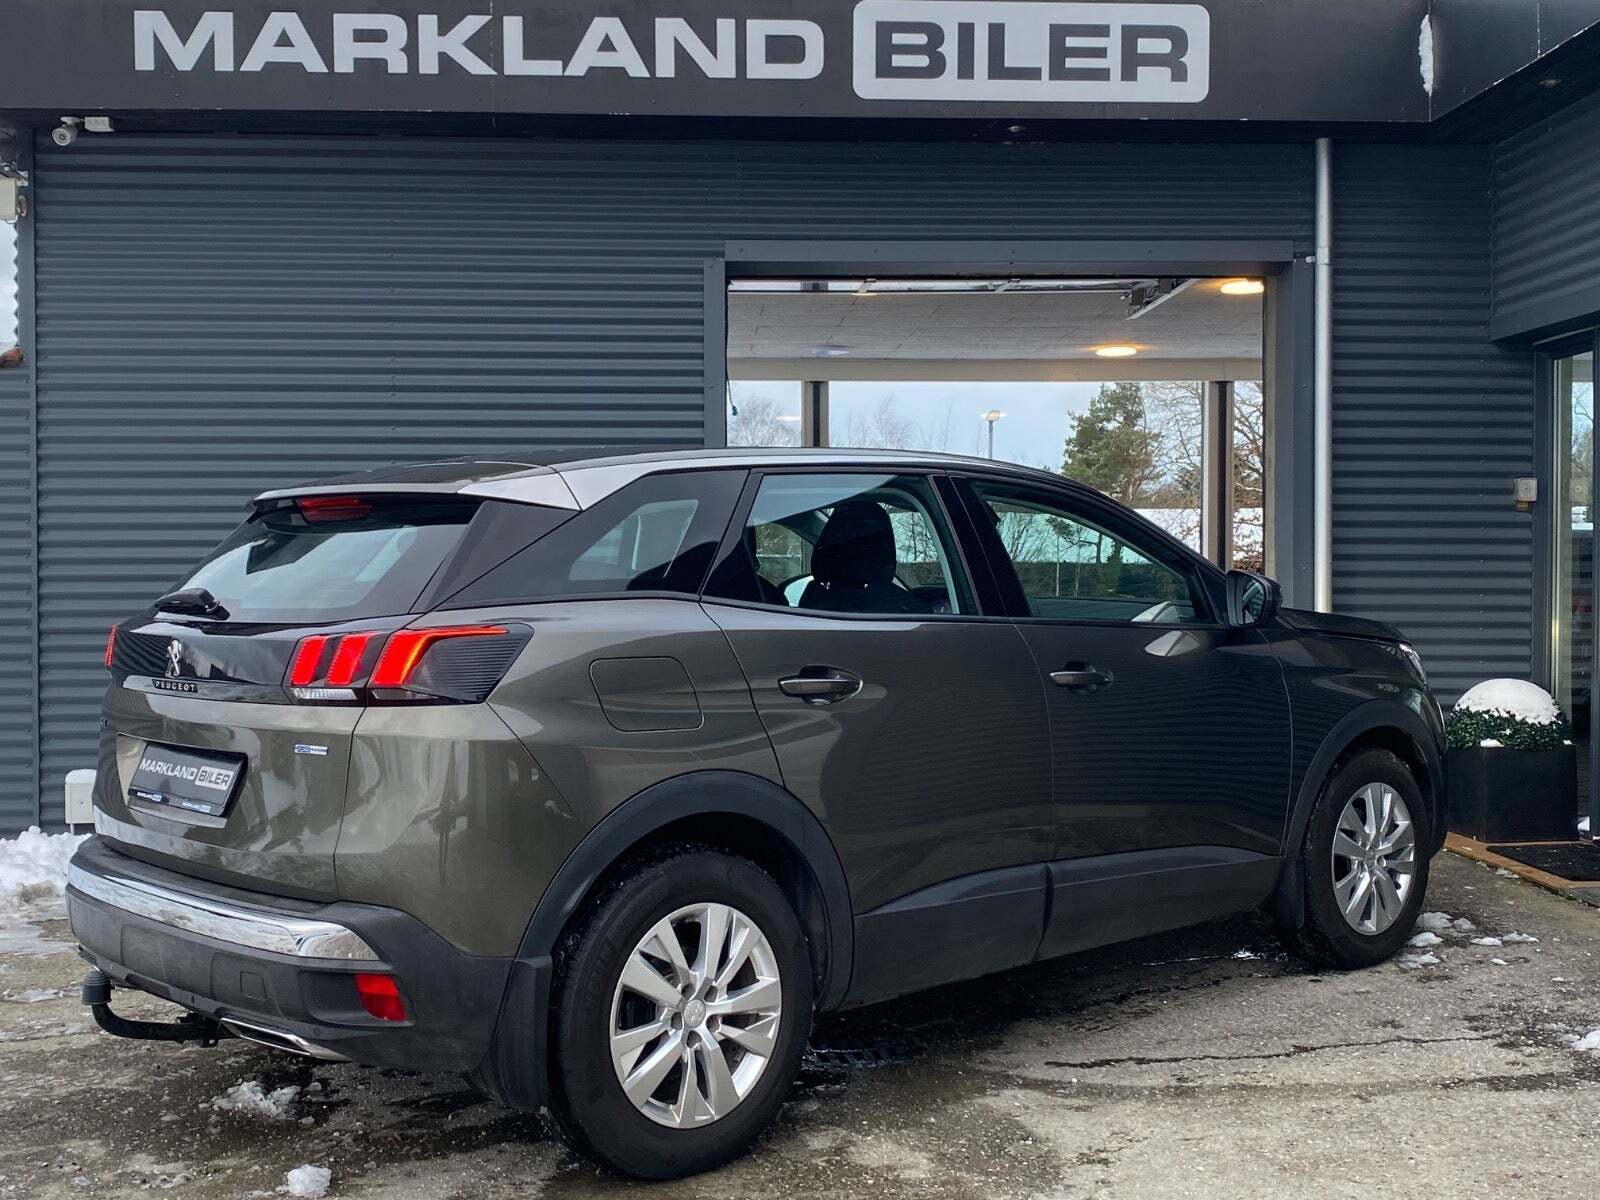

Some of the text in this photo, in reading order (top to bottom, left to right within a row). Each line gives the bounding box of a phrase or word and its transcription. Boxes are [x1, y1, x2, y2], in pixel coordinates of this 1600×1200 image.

[133, 10, 1189, 82] MARKLAND BILER
[155, 680, 196, 692] PEUGEOT
[139, 758, 231, 786] MARKLAND BILER
